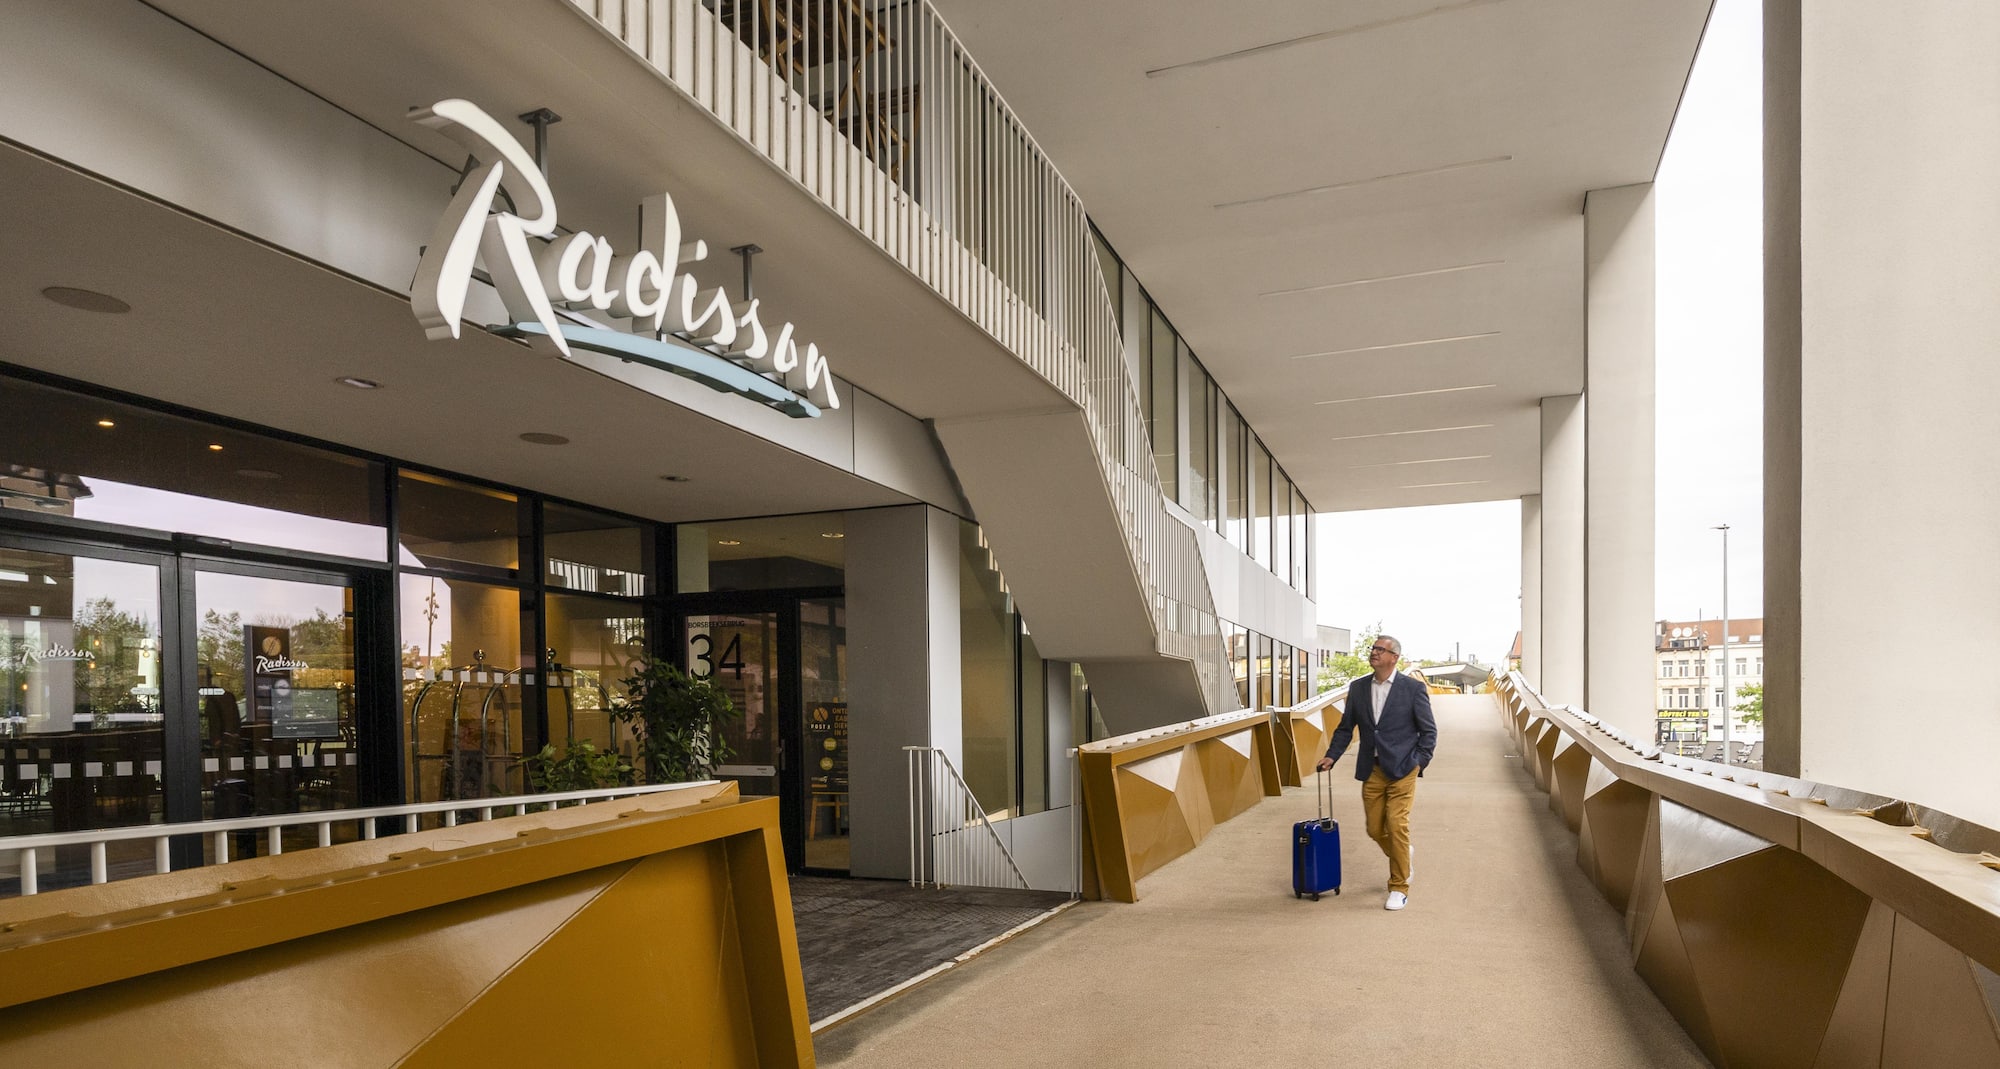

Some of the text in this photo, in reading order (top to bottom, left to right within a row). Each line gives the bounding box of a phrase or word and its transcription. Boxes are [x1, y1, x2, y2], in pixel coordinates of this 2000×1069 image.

[432, 98, 840, 410] Radisson
[20, 642, 96, 665] Radisson
[255, 654, 310, 674] Radisson
[690, 633, 746, 681] 34
